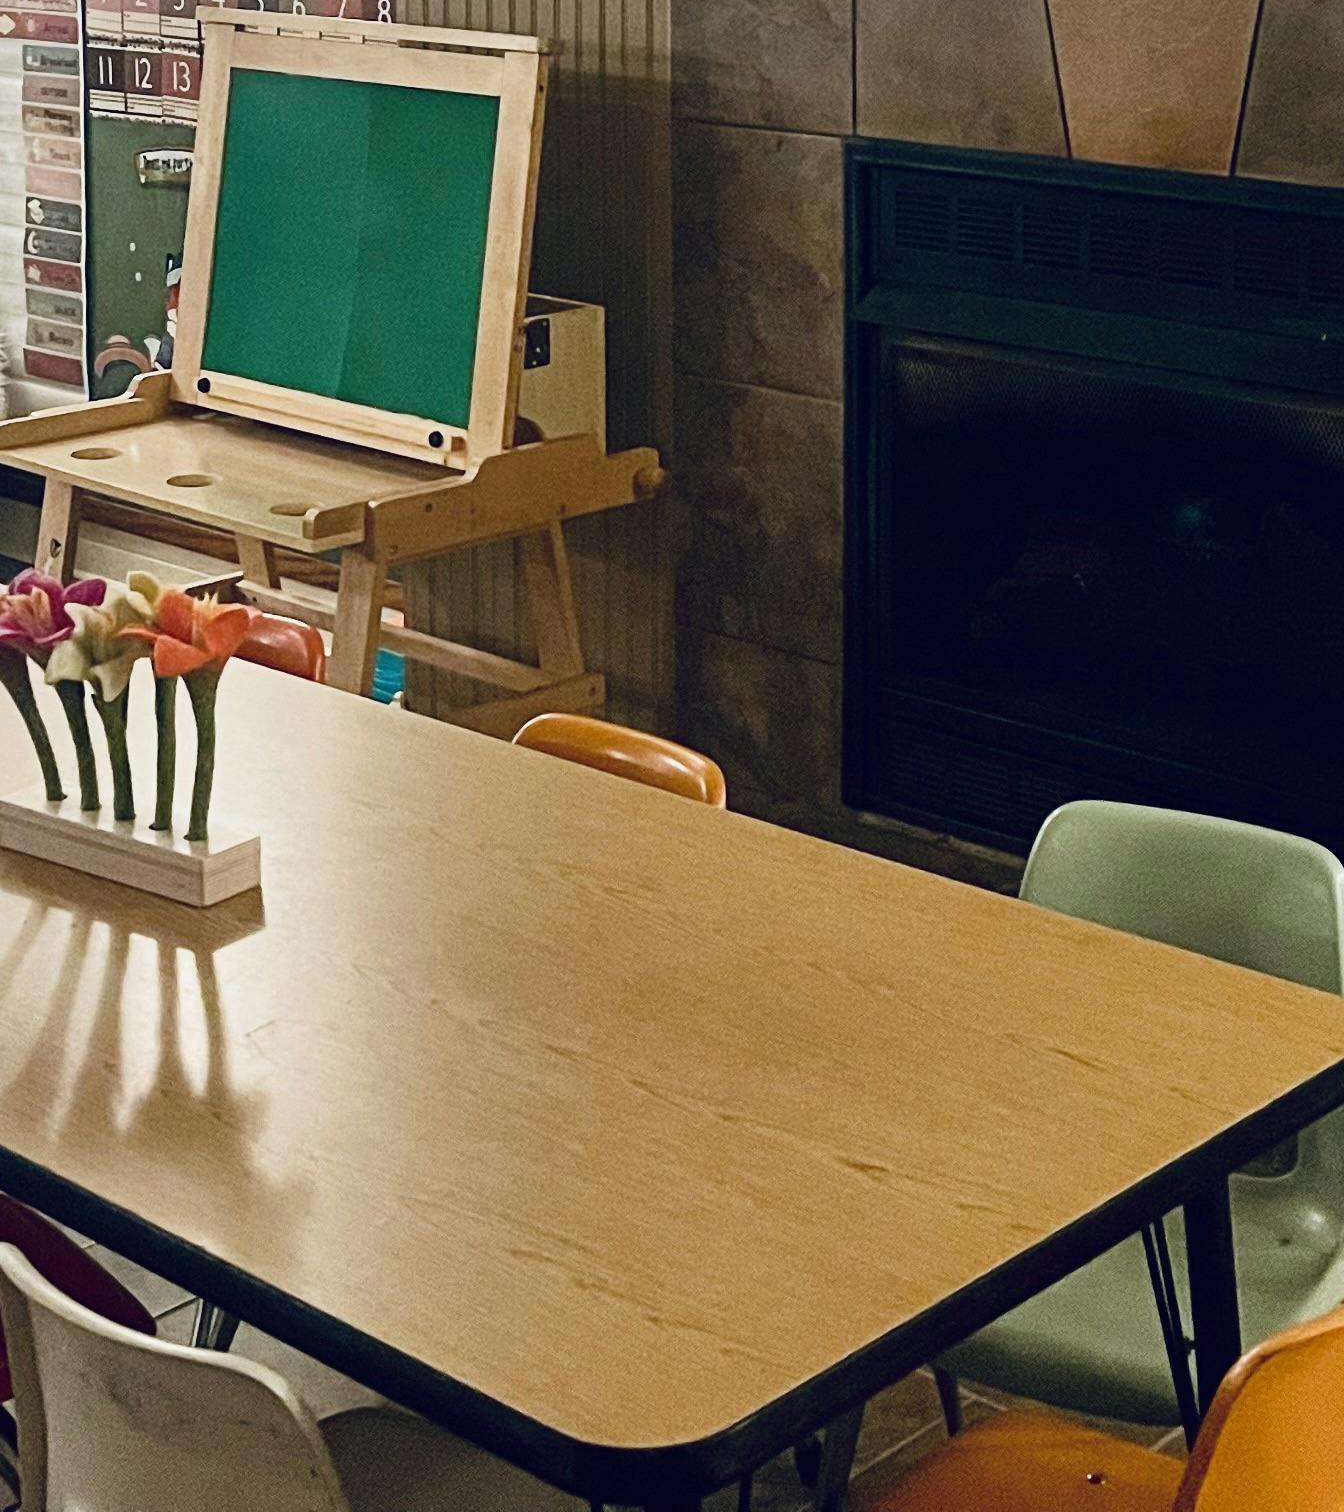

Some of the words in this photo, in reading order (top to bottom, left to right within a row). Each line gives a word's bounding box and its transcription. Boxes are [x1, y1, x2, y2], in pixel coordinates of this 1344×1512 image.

[99, 55, 113, 85] 11
[135, 57, 153, 89] 12
[173, 61, 191, 92] 13
